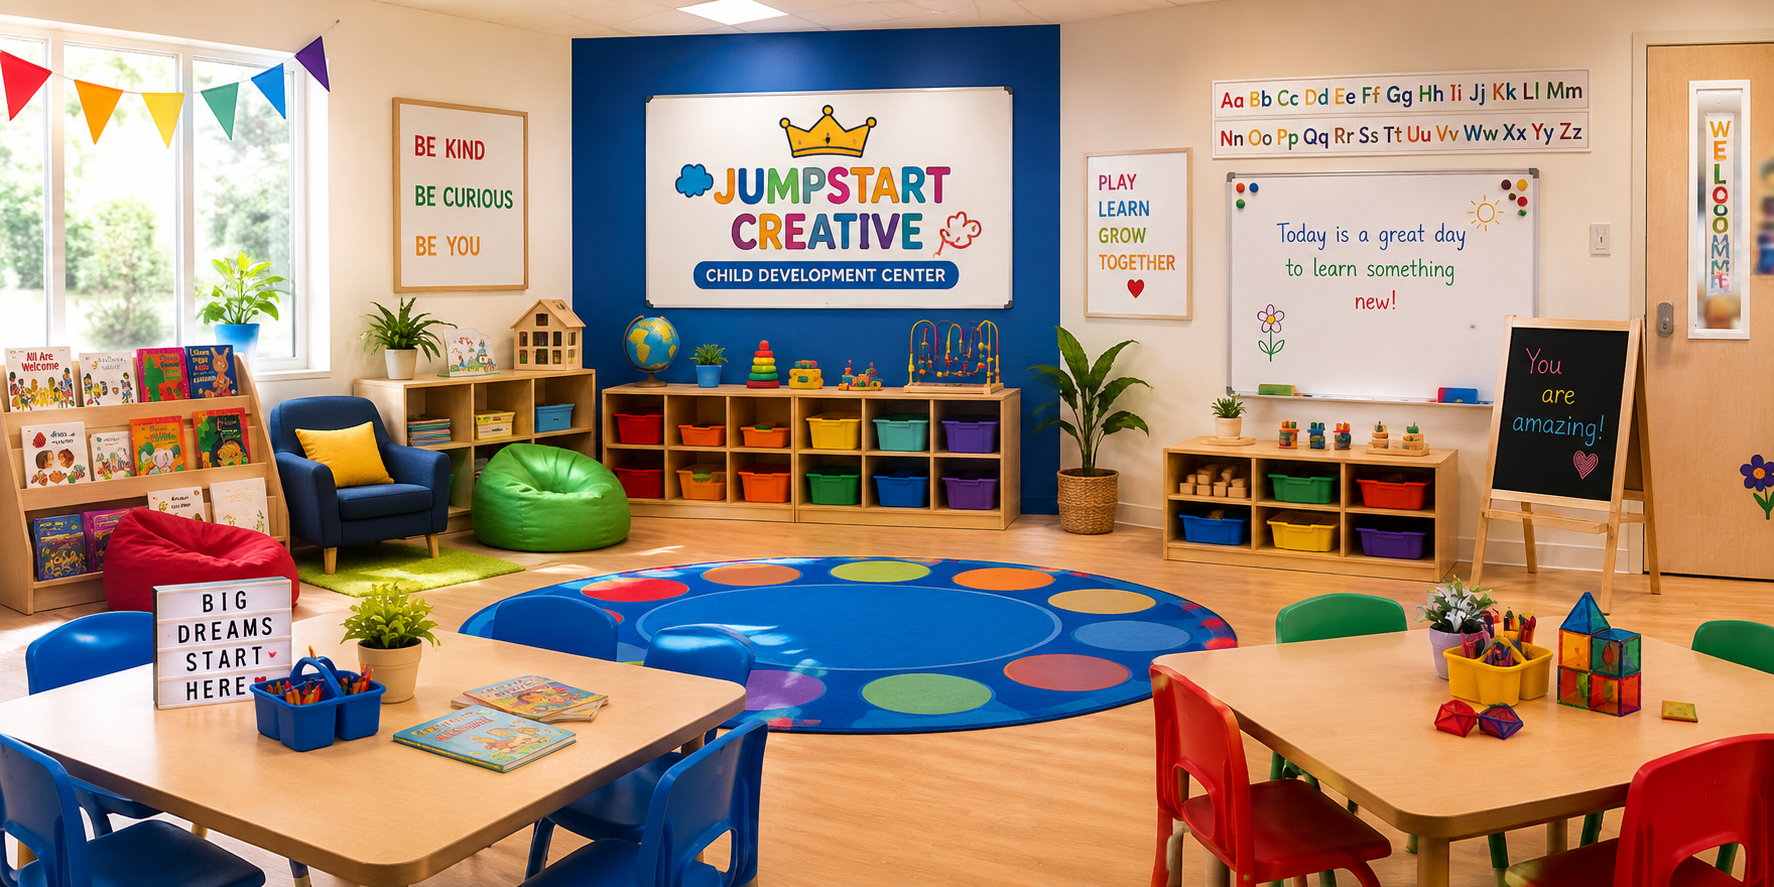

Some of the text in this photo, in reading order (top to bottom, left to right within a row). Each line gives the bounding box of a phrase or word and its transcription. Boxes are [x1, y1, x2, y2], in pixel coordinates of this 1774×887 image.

[1221, 82, 1582, 108] Aa Bb Cc Dd Ee Ff Gg Hh Ii Jj Kk Ll Mm
[415, 135, 485, 160] BE KIND
[1221, 123, 1582, 150] Nn Oo Pp Qq Rr Ss Tt Uu Vv Ww Xx Yy Zz
[714, 166, 950, 204] JUMPSTART
[1099, 174, 1136, 190] PLAY
[416, 185, 513, 209] BE CURIOUS
[1099, 201, 1149, 217] LEARN
[732, 213, 923, 250] CREATIVE
[1099, 227, 1146, 243] GROW
[1277, 223, 1465, 251] Today is a great day
[416, 236, 480, 256] BE YOU
[1099, 254, 1175, 270] TOGETHER
[1286, 257, 1454, 286] to learn something
[706, 269, 945, 282] CHILD DEVELOPMENT CENTER
[1356, 290, 1395, 309] new!
[21, 362, 60, 372] Welcome
[39, 351, 54, 361] Are
[1526, 348, 1561, 374] You
[1542, 389, 1574, 404] are
[1513, 415, 1604, 446] amazing!
[203, 591, 246, 612] BIG
[178, 617, 272, 643] DREAMS
[187, 646, 262, 671] START
[187, 677, 245, 700] HERE
